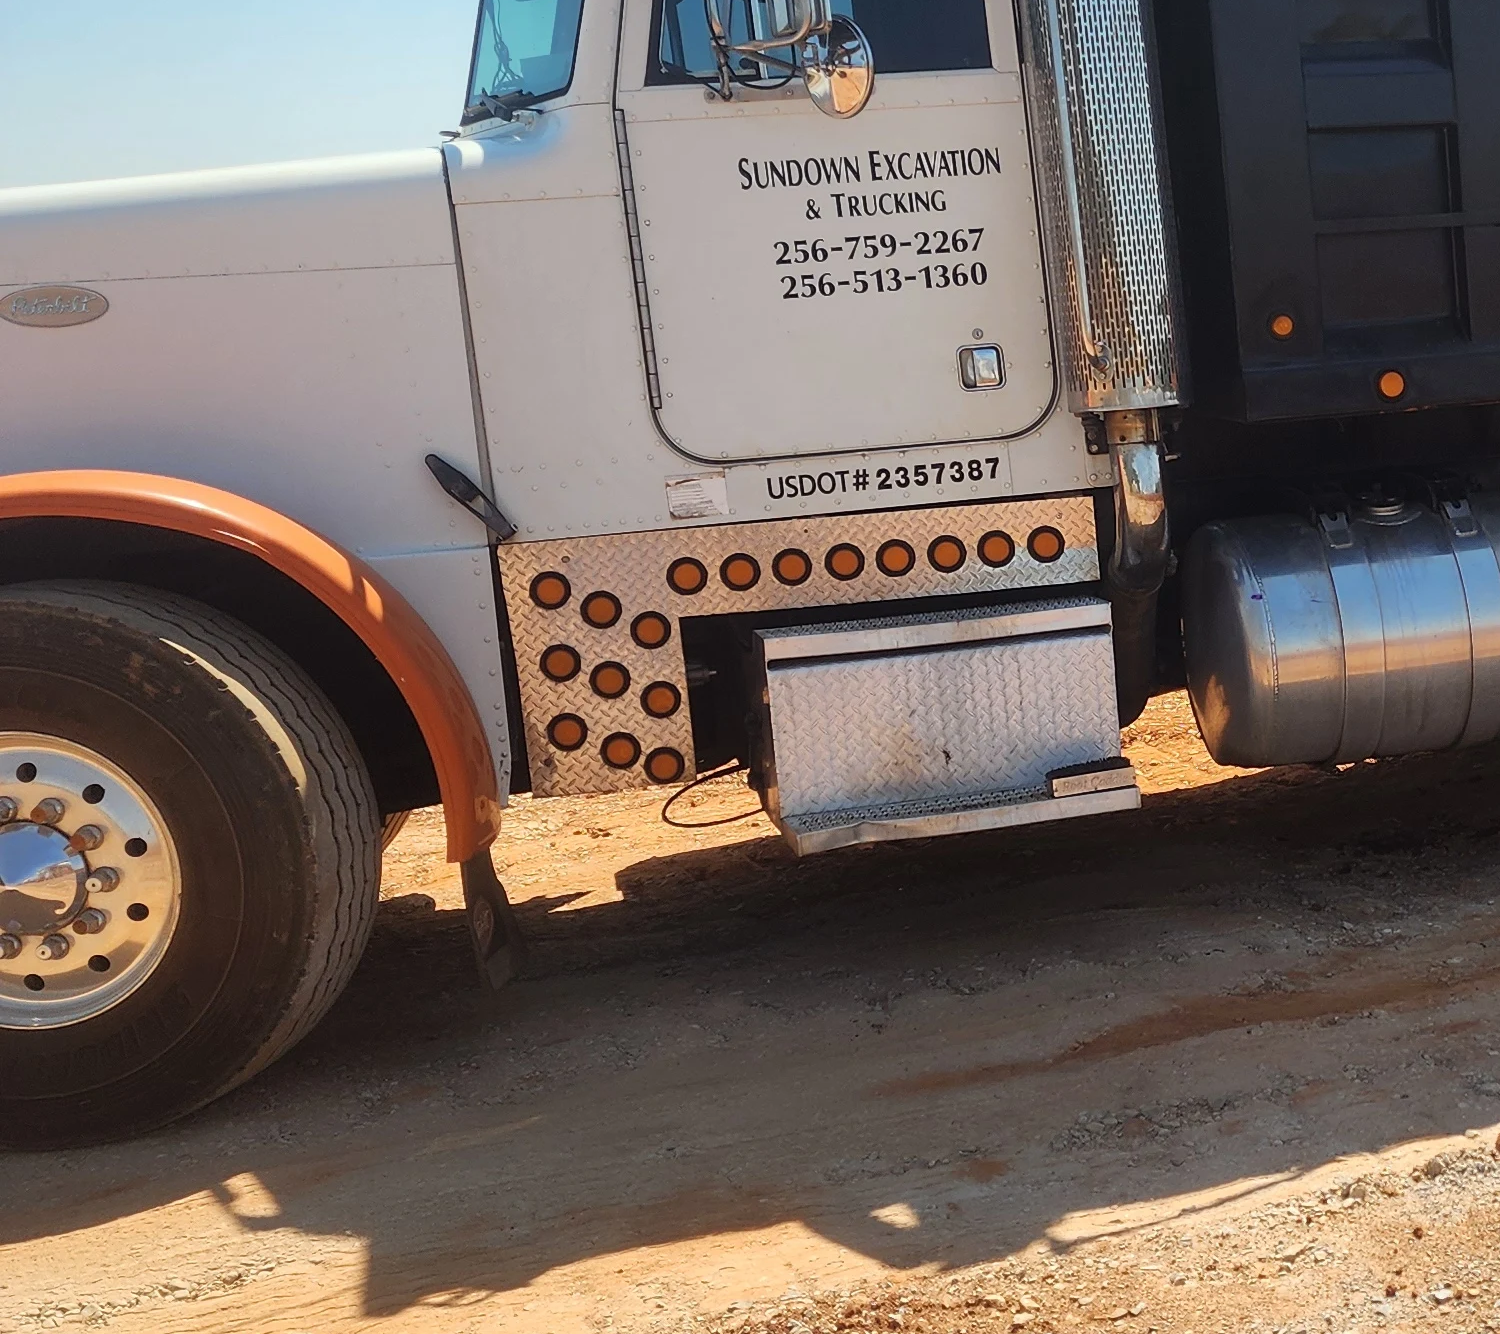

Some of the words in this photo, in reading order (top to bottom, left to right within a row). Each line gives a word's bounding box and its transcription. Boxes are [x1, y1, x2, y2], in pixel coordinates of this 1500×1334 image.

[738, 155, 861, 191] SUNDOWN
[868, 148, 1002, 182] EXCAVATION
[805, 198, 822, 221] &
[830, 189, 947, 218] TRUCKING
[773, 227, 985, 266] 256-759-2267
[780, 261, 988, 300] 256-513-1360
[11, 294, 97, 316] Peterbilt
